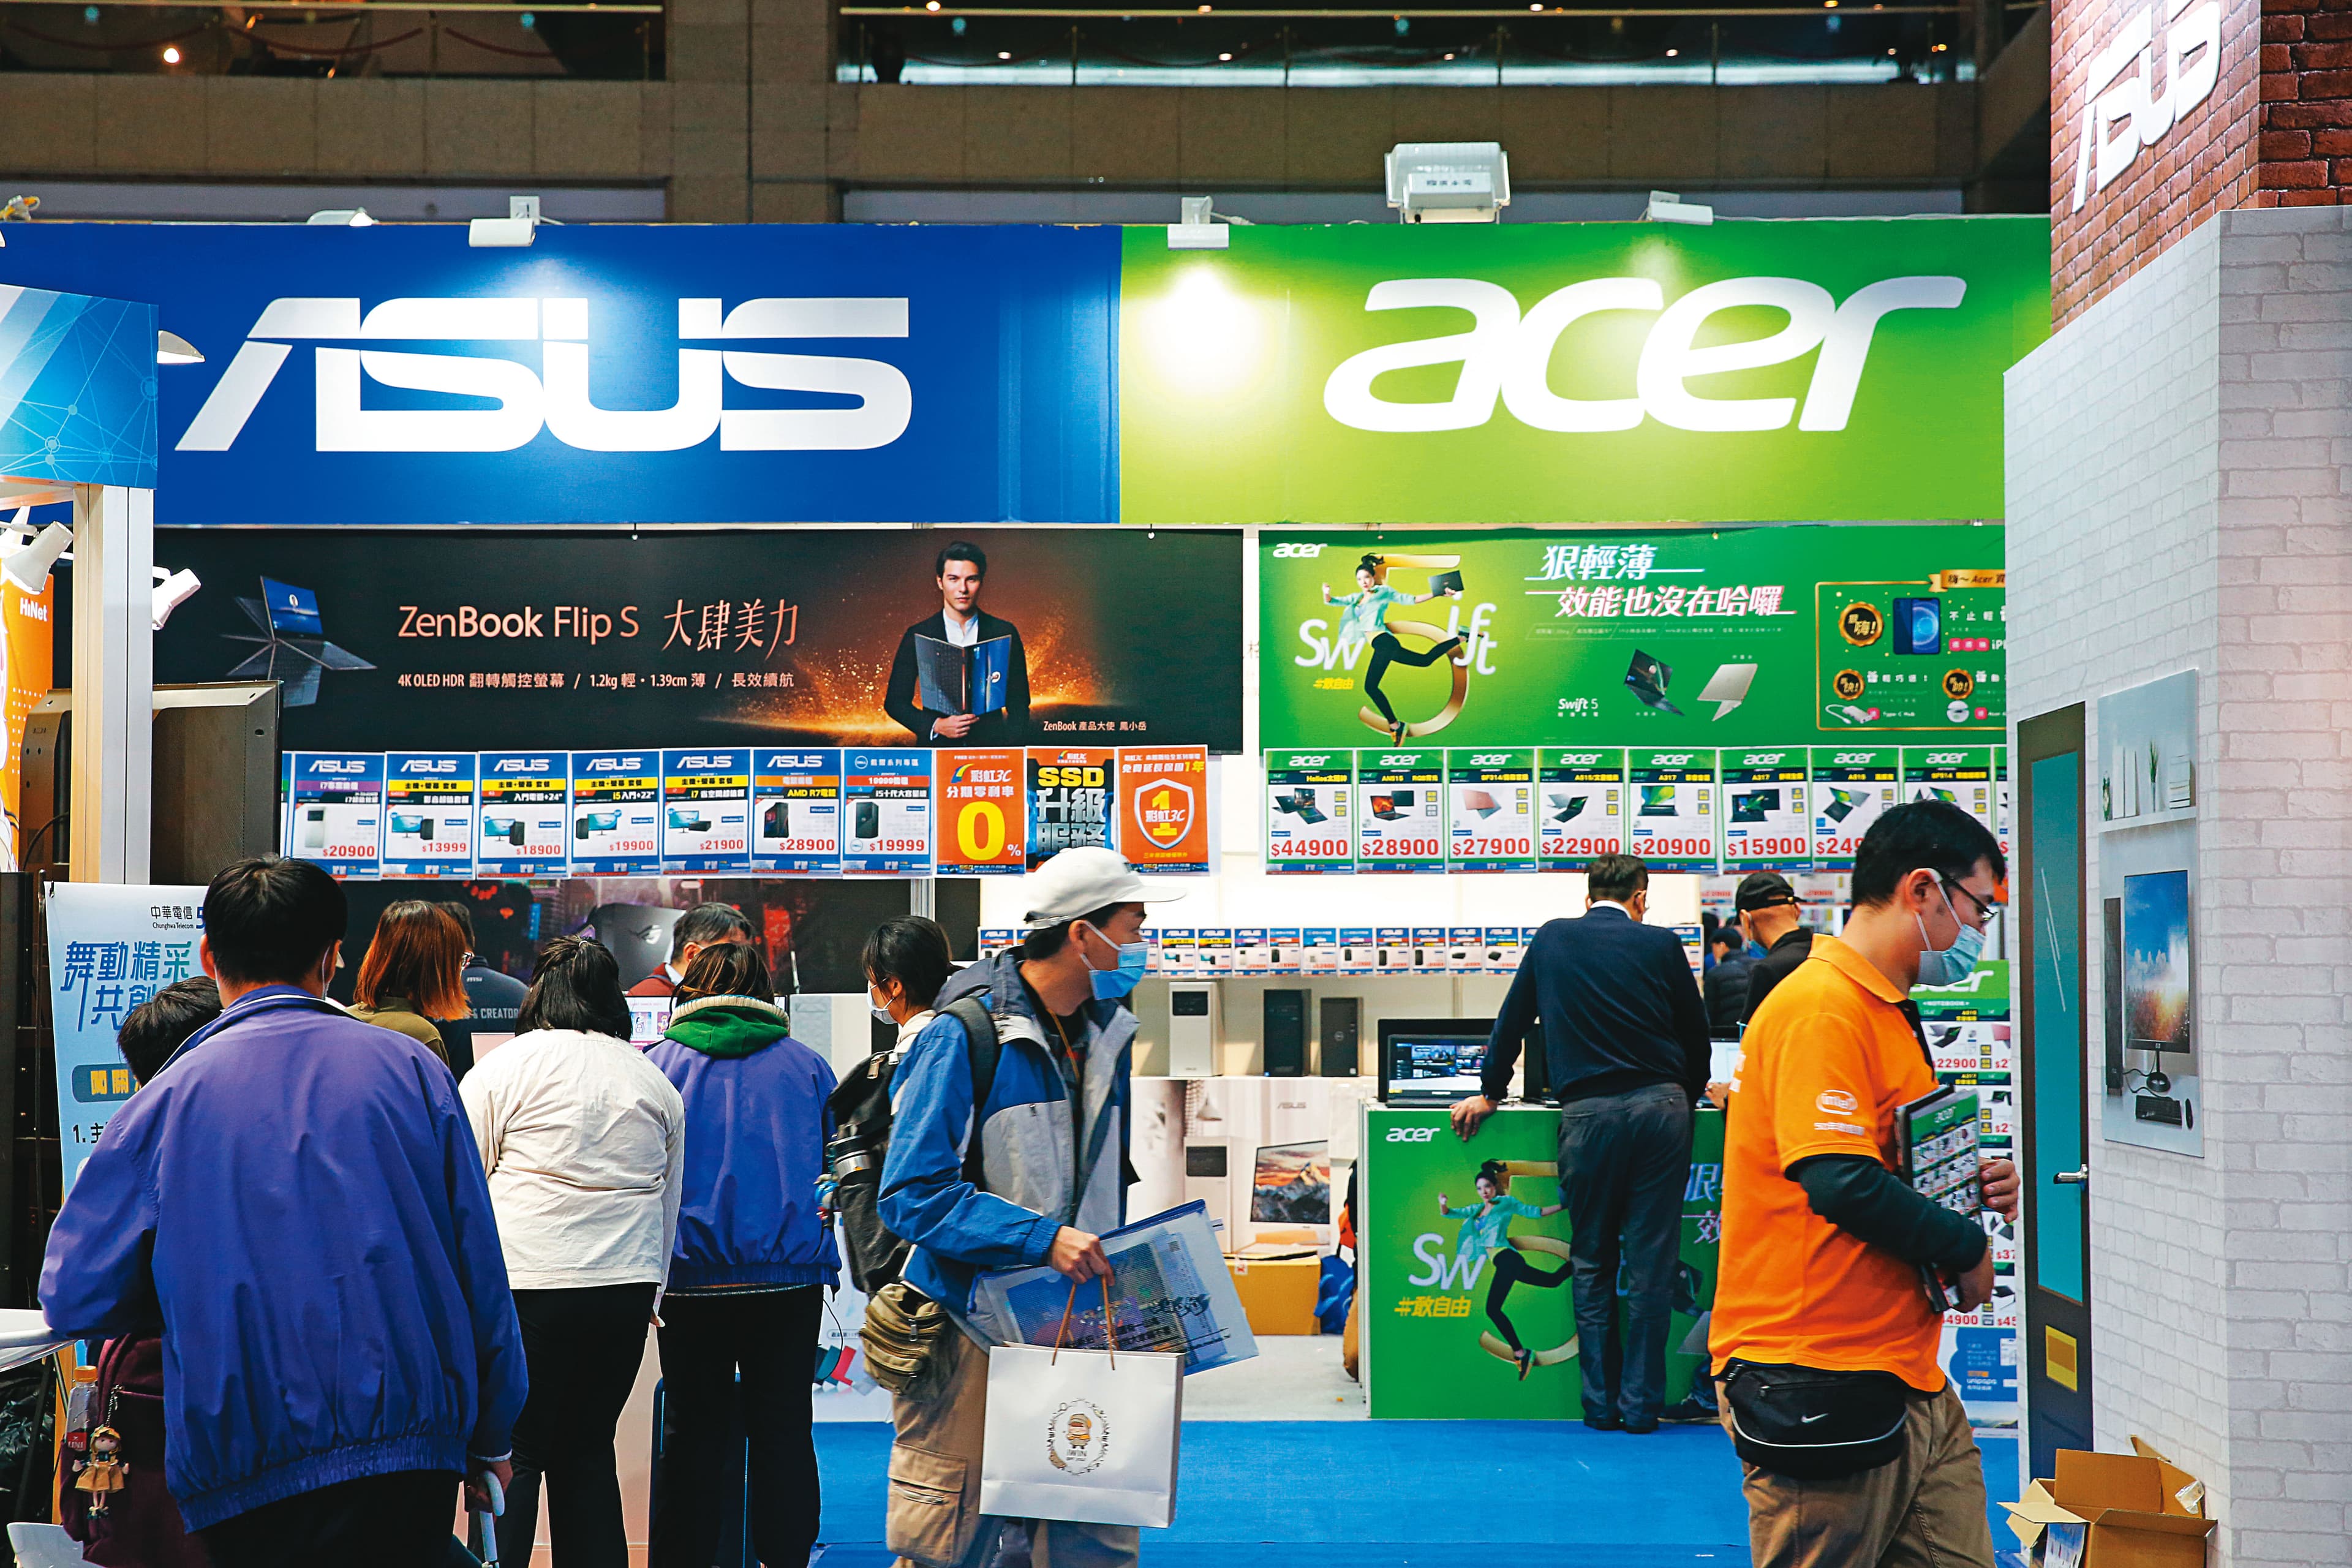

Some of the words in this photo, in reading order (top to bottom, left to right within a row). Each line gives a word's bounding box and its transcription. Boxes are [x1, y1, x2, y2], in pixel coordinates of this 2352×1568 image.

[1323, 276, 1967, 432] acer
[175, 297, 912, 452] ASUS
[1272, 543, 1328, 558] acer
[1540, 543, 1658, 581] 狠輕薄
[1555, 584, 1785, 617] 效能也沒在哈囉
[20, 598, 47, 622] HiNet
[398, 606, 543, 638] ZenBook
[554, 606, 611, 645] Flip
[620, 606, 639, 638] S
[662, 598, 798, 660] 大肆美力
[398, 674, 412, 687] 4K
[413, 674, 440, 687] OLED
[442, 674, 465, 687] HDR
[469, 673, 565, 688] 翻轉觸控螢幕
[590, 674, 618, 690] 1.2kg
[691, 673, 706, 688] 薄
[732, 673, 794, 688] 長效續航
[1558, 698, 1589, 712] Swift
[1591, 698, 1599, 710] 5
[1043, 720, 1077, 731] ZenBook
[1079, 720, 1115, 732] 產品大使
[586, 758, 641, 771] ASUS
[677, 755, 732, 769] ASUS
[767, 755, 823, 767] ASUS
[1289, 756, 1330, 766] acer
[1379, 755, 1421, 766] acer
[1470, 754, 1512, 765] acer
[1561, 754, 1602, 764] acer
[1651, 754, 1694, 765] acer
[1743, 753, 1786, 764] acer
[1834, 753, 1876, 764] acer
[1926, 753, 1968, 764] acer
[309, 760, 366, 773] ASUS
[401, 760, 457, 772] ASUS
[494, 759, 549, 772] ASUS
[1038, 767, 1104, 787] SSD
[946, 786, 1014, 798] 分期零利率
[1036, 788, 1106, 822] 升級
[1146, 810, 1185, 823] 彩虹3C
[323, 845, 374, 857] $20900
[423, 843, 466, 852] $13999
[517, 845, 560, 854] $18900
[610, 841, 654, 851] $19900
[700, 840, 744, 850] $21900
[780, 839, 835, 850] $28900
[870, 840, 924, 851] $19999
[1272, 840, 1348, 857] $44900
[1362, 839, 1439, 856] $28900
[1453, 839, 1529, 856] $27900
[1542, 839, 1619, 854] $22900
[1633, 839, 1711, 856] $20900
[1728, 837, 1805, 856] $15900
[151, 906, 193, 919] 中華電信
[61, 940, 191, 1031] 舞動精采
[91, 1069, 142, 1095] 闖關
[1386, 1128, 1440, 1142] acer
[1395, 1296, 1471, 1317] #敢自由
